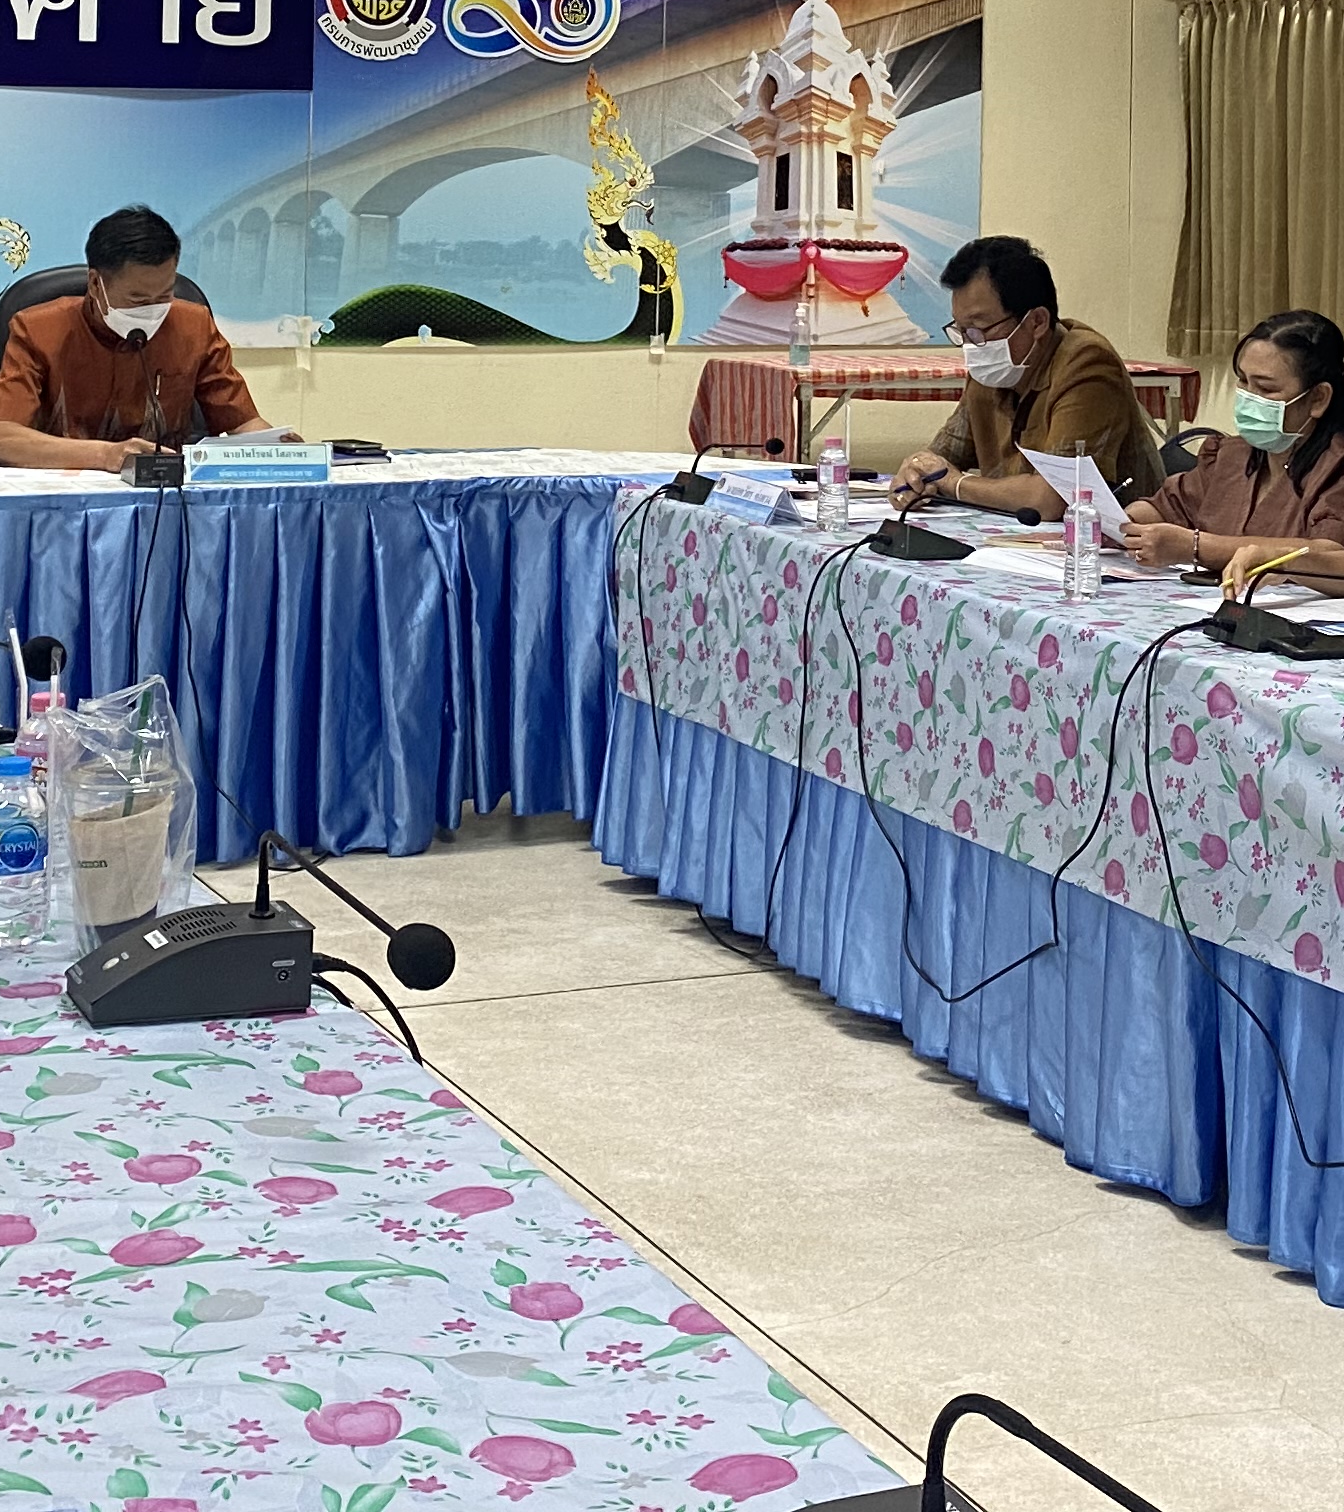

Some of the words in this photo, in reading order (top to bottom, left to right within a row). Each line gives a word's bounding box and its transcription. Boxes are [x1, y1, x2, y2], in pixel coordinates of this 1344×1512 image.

[321, 16, 435, 59] กรมการพัฒนาชุมชน
